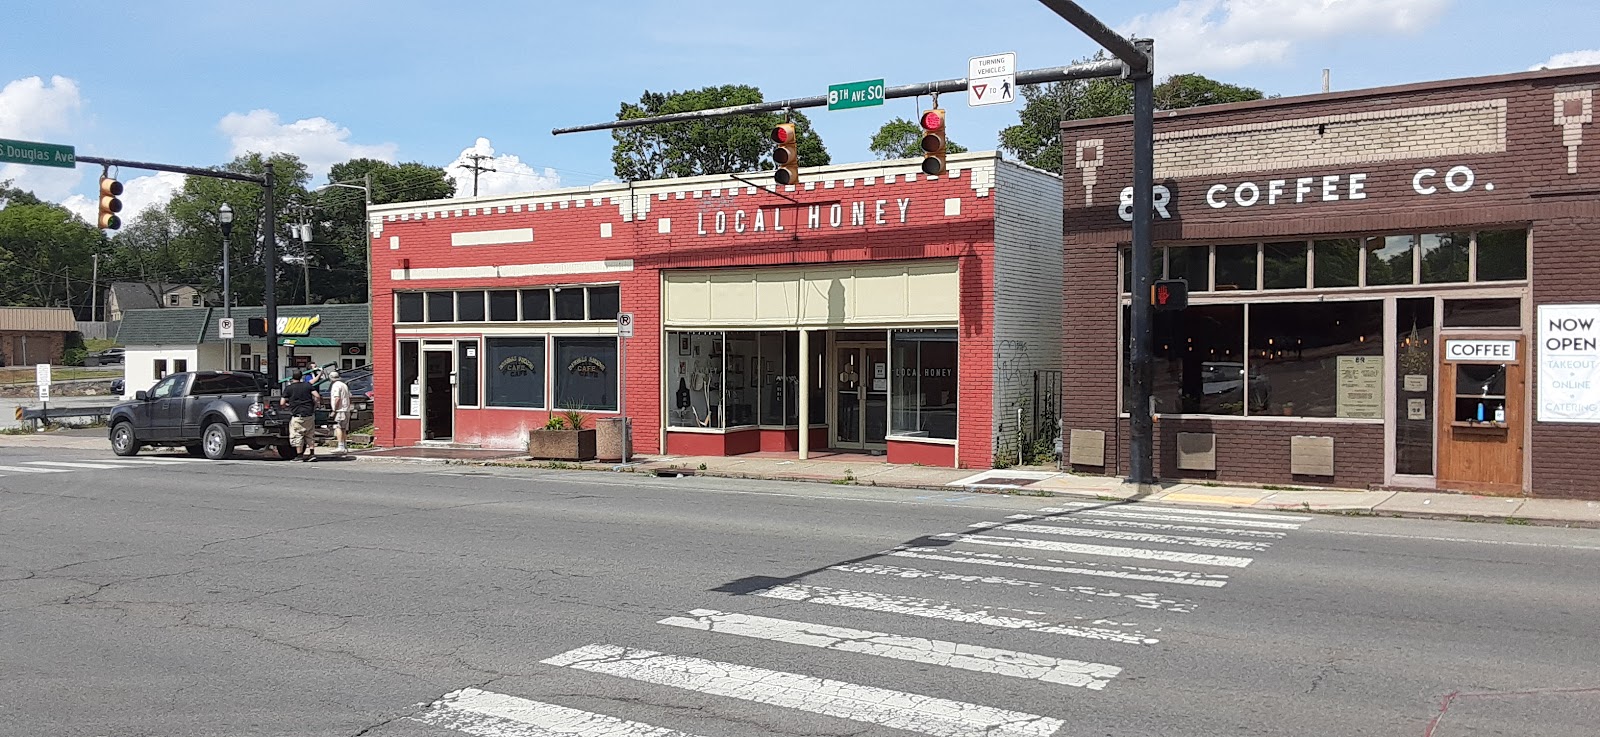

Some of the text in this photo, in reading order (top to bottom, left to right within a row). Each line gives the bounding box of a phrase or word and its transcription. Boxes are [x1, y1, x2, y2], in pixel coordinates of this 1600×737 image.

[979, 58, 1005, 66] TURNING
[977, 66, 1006, 75] VEHICLES
[829, 89, 849, 104] 8TH
[851, 90, 866, 102] AVE
[7, 145, 50, 163] Douglas
[54, 150, 74, 162] Ave
[1206, 173, 1367, 209] COFFEE
[1412, 165, 1494, 195] CO.
[697, 198, 910, 235] LOCAL HONEY
[277, 314, 320, 335] BWAY
[1549, 318, 1595, 331] NOW
[1451, 344, 1511, 356] COFFEE
[1546, 338, 1597, 351] OPEN
[1547, 360, 1596, 369] TAKEOUT
[924, 368, 953, 377] HONEY
[1552, 380, 1591, 389] ONLINE
[1545, 402, 1598, 412] CATERING
